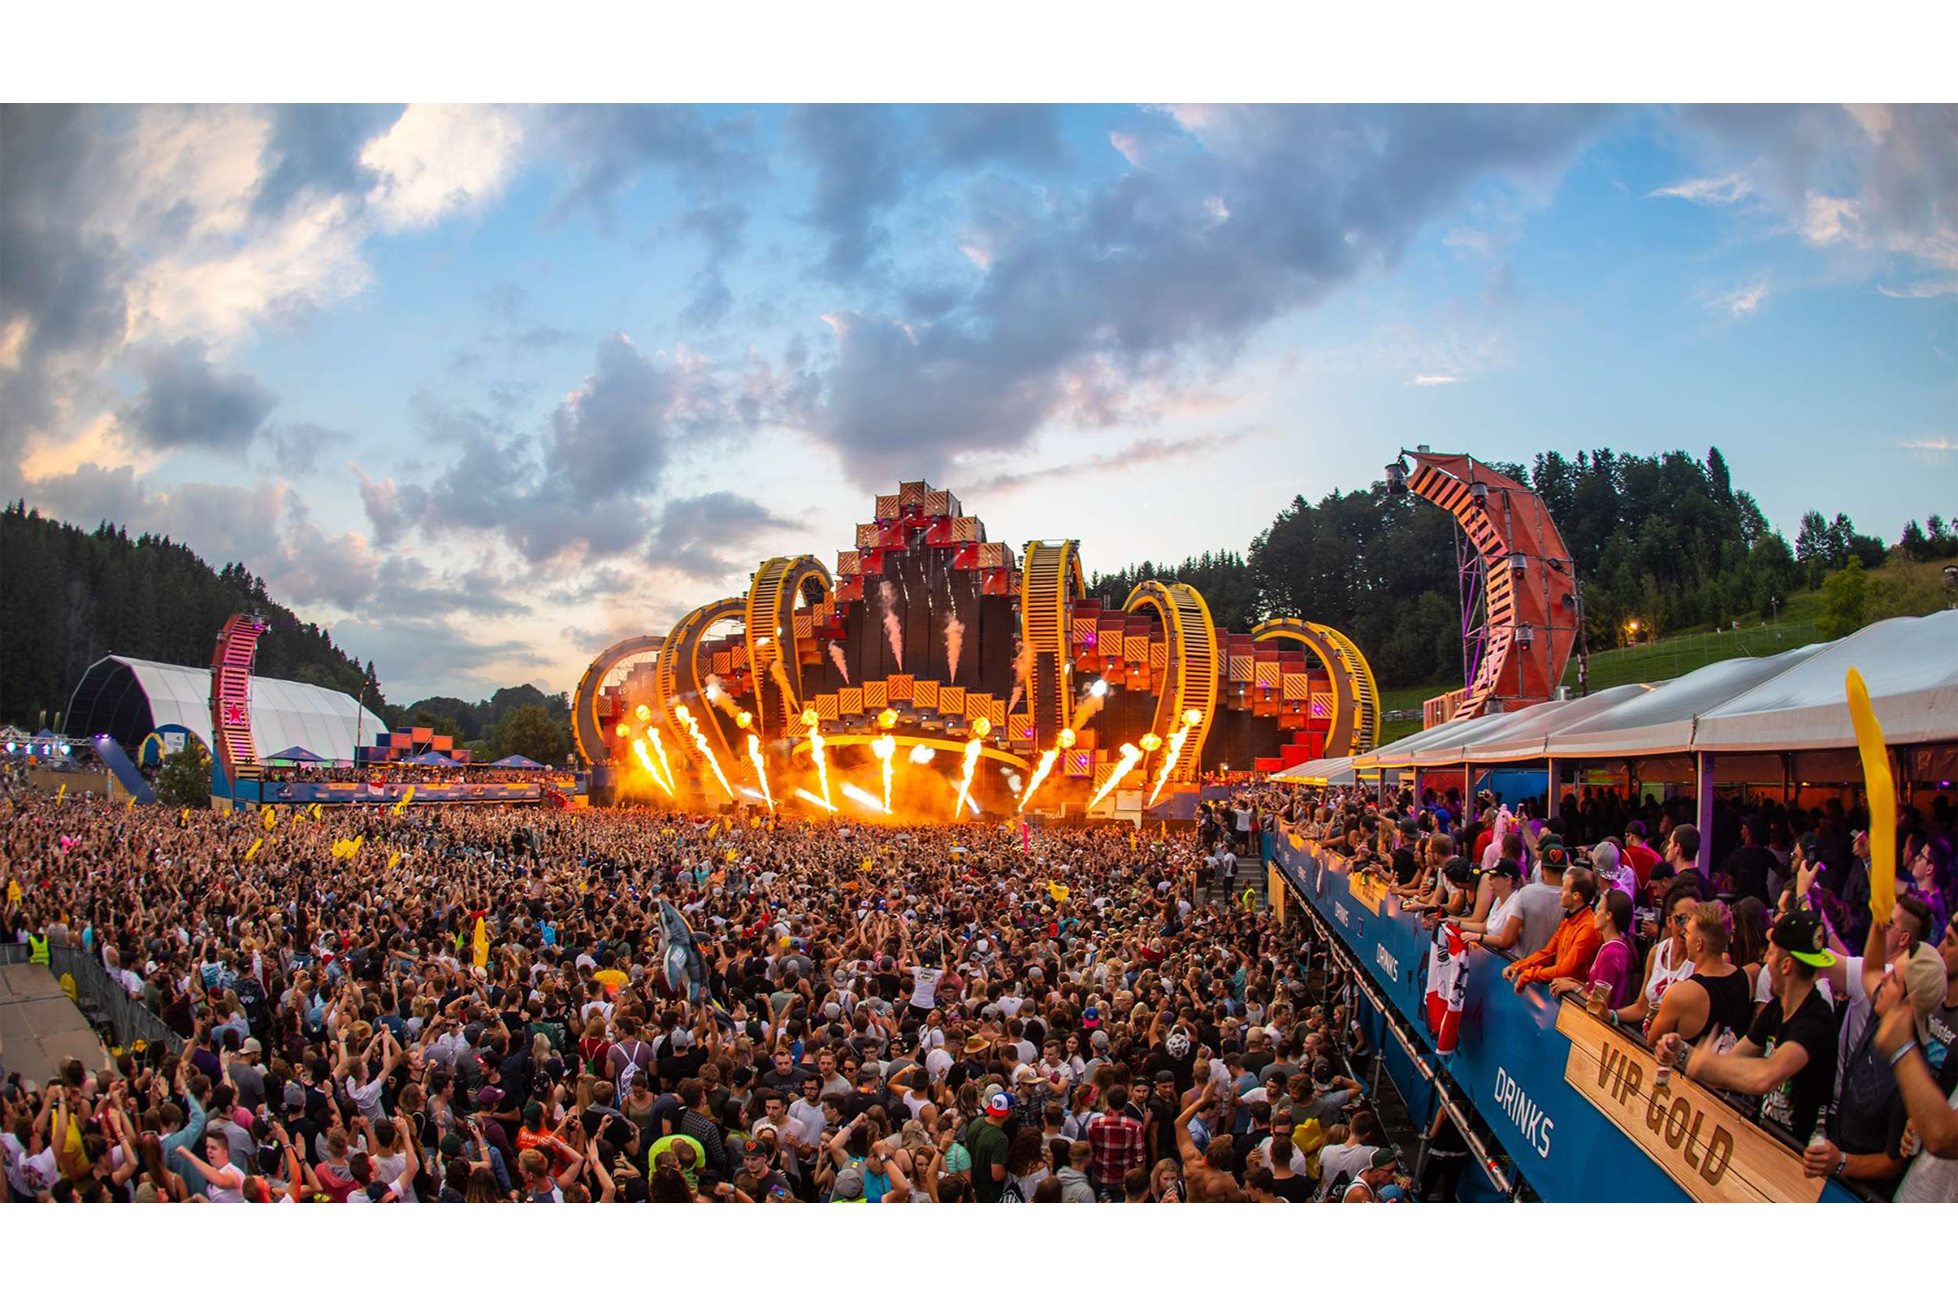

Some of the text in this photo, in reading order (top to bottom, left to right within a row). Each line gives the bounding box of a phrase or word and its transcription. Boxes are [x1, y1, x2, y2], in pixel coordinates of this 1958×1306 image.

[1377, 943, 1398, 982] DRINKS
[1494, 1066, 1554, 1158] DRINKS
[1597, 1041, 1643, 1107] VIP
[1646, 1084, 1734, 1187] GOLD
